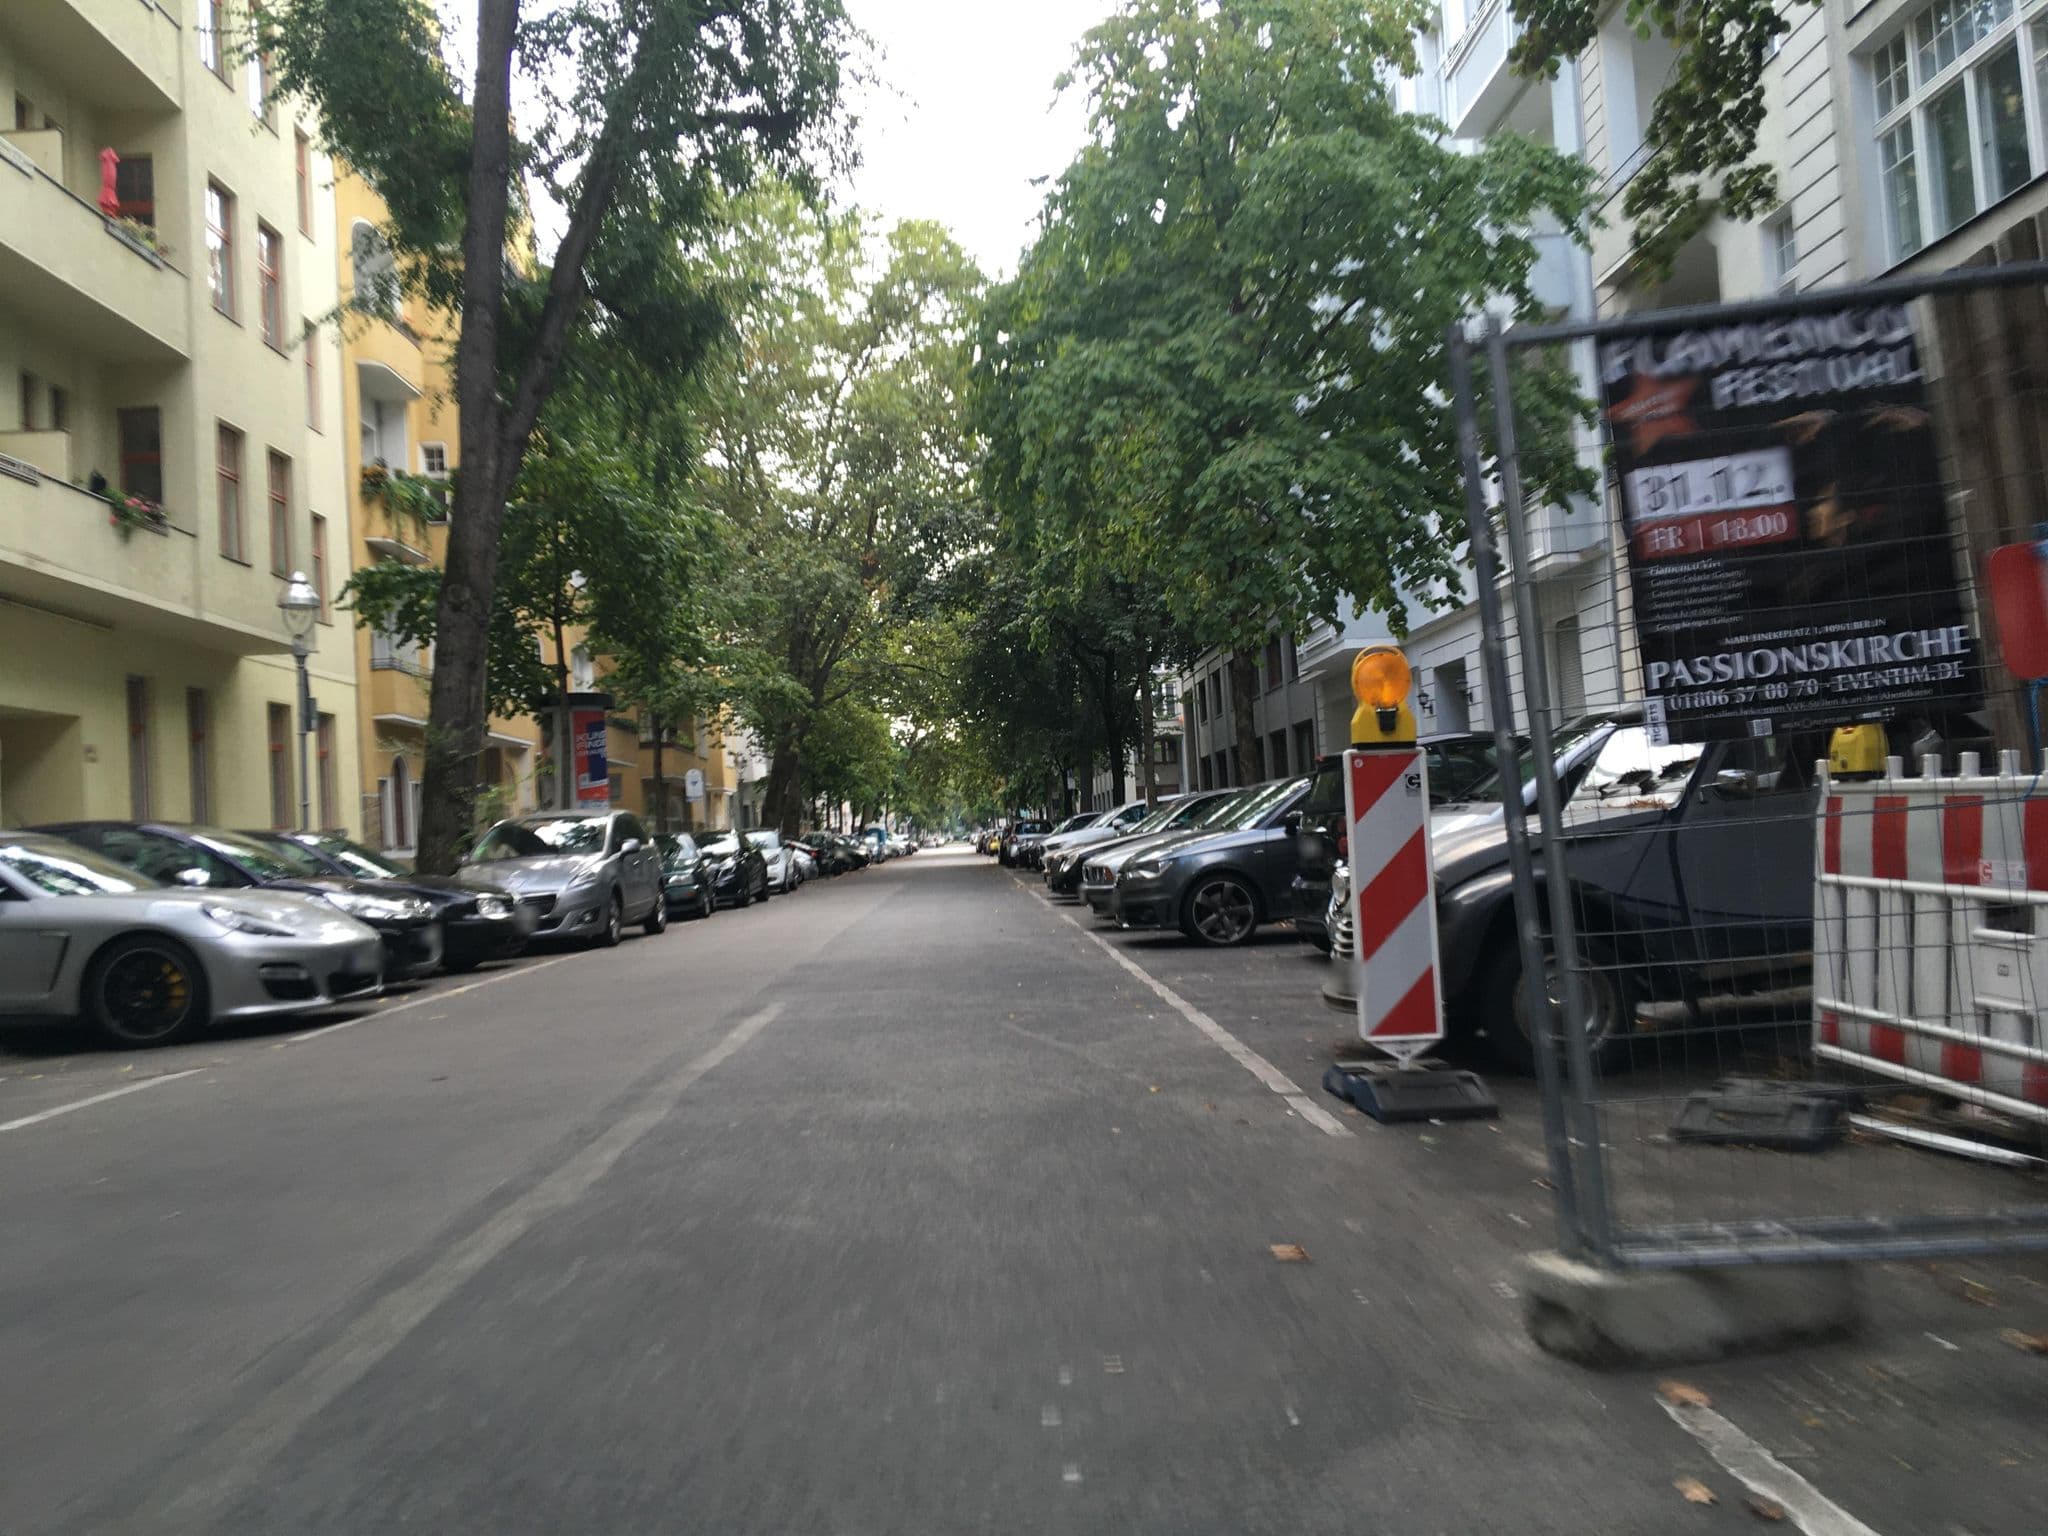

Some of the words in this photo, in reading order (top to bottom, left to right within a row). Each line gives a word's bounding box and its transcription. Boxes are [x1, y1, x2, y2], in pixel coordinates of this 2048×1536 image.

[1712, 346, 1926, 410] FESTIVAL
[1647, 624, 1972, 690] PASSIONSKIRCHE
[1793, 678, 1819, 697] 70
[1831, 660, 1965, 692] EVENTIM.DE
[1649, 703, 1661, 743] TICKETS
